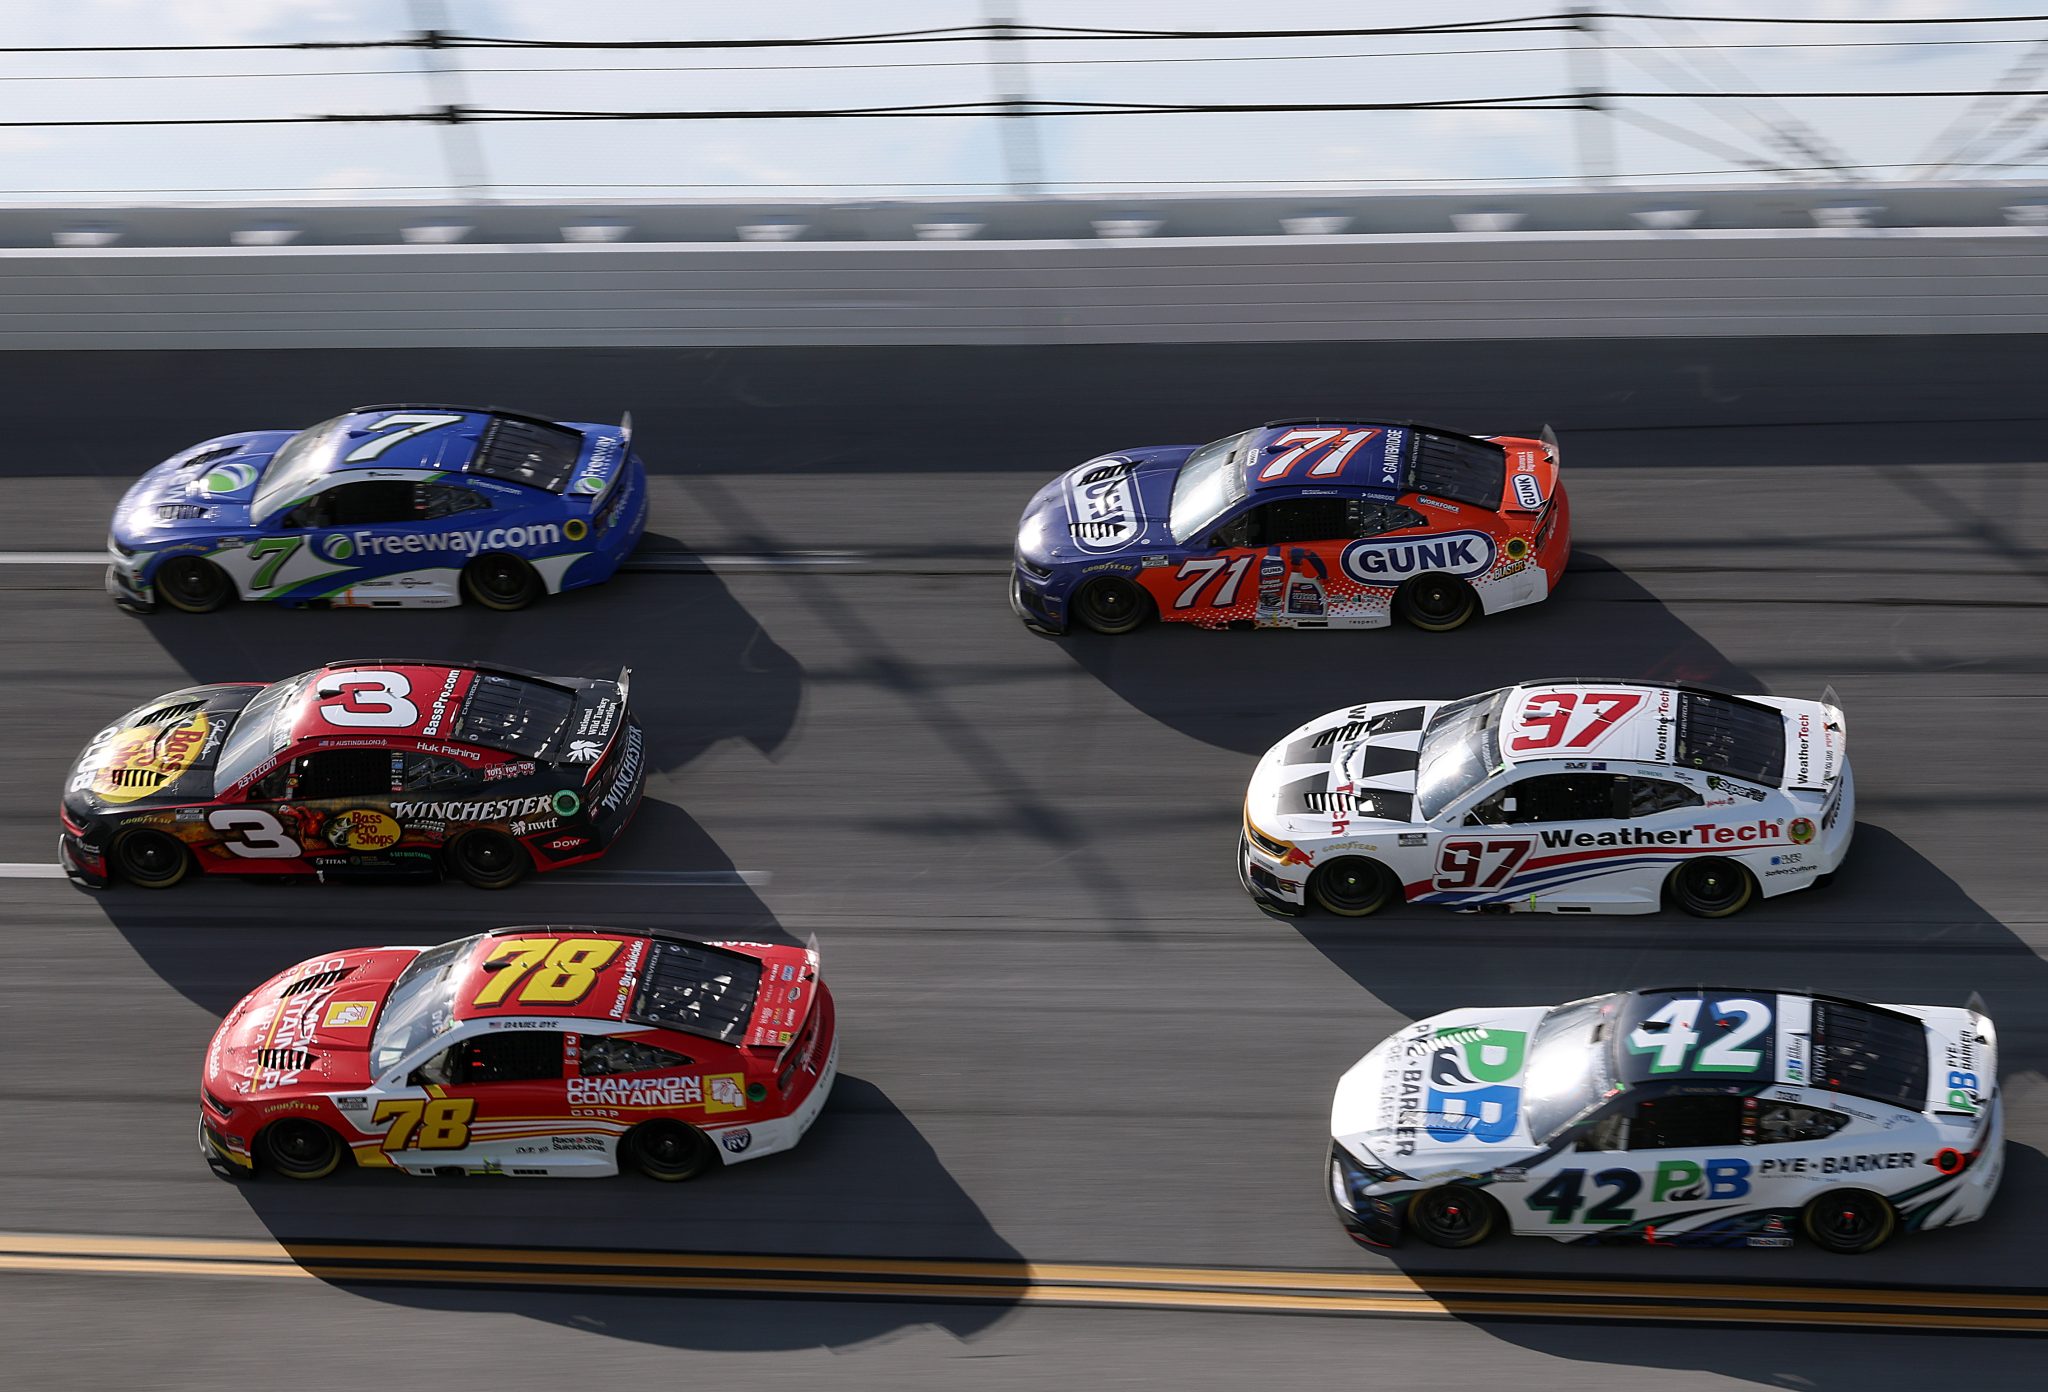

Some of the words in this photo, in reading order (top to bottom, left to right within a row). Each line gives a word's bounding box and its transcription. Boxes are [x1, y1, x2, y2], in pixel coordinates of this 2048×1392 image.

[344, 414, 465, 464] 7
[1258, 427, 1382, 482] 71
[1382, 429, 1403, 474] GAINBRIDGE
[1419, 496, 1461, 513] WORKFORCE
[1517, 476, 1537, 506] GUNK
[354, 523, 561, 558] Freeway.com
[1358, 538, 1479, 574] GUNK
[248, 535, 304, 590] 7
[1082, 562, 1133, 574] GOODYEAR
[1174, 554, 1257, 610] 71
[316, 670, 419, 728] 3
[423, 669, 461, 736] BassPro.com
[462, 674, 482, 716] CHEVROLET
[577, 708, 594, 735] National
[588, 715, 600, 736] Wild
[595, 697, 610, 718] Turkey
[598, 702, 617, 737] Federation
[1512, 693, 1642, 750] 97
[1655, 689, 1670, 761] WeatherTech
[1681, 695, 1689, 738] CHEVROLET
[160, 729, 205, 773] Bass
[416, 741, 439, 753] Huk
[441, 745, 481, 761] Fishing
[1797, 713, 1809, 784] WeatherTech
[487, 767, 503, 777] TOYS
[505, 765, 518, 773] FOR
[602, 725, 643, 813] WINCHESTER
[352, 811, 382, 824] Bass
[390, 794, 553, 822] WINCHESTER
[414, 819, 446, 828] LONG
[528, 817, 558, 831] nwtf
[208, 808, 301, 858] 3
[354, 822, 377, 834] Pro
[357, 832, 394, 847] Shops
[404, 823, 445, 833] BEARD
[1322, 840, 1378, 852] GOODYEAR
[1540, 820, 1780, 848] WeatherTech
[1438, 841, 1533, 888] 97
[472, 938, 626, 1008] 78
[642, 943, 663, 992] CHEVROLET
[609, 993, 627, 1018] Race
[503, 1021, 538, 1029] DANIEL
[539, 1021, 559, 1029] DYE
[1626, 998, 1772, 1074] 42
[1812, 1044, 1827, 1081] TOYOTA
[567, 1076, 701, 1092] CHAMPION
[567, 1088, 703, 1105] CONTAINER
[1948, 1070, 1979, 1113] PB
[265, 1101, 320, 1113] GOODYEAR
[372, 1098, 478, 1151] 78
[570, 1109, 620, 1118] CORP
[1395, 1069, 1422, 1157] BARKER
[552, 1136, 576, 1145] Race
[584, 1136, 605, 1147] Stop
[552, 1142, 607, 1153] Suicide.com
[1652, 1157, 1753, 1203] PB
[1760, 1157, 1807, 1174] PYE
[1821, 1152, 1916, 1174] BARKER
[1525, 1167, 1643, 1225] 42
